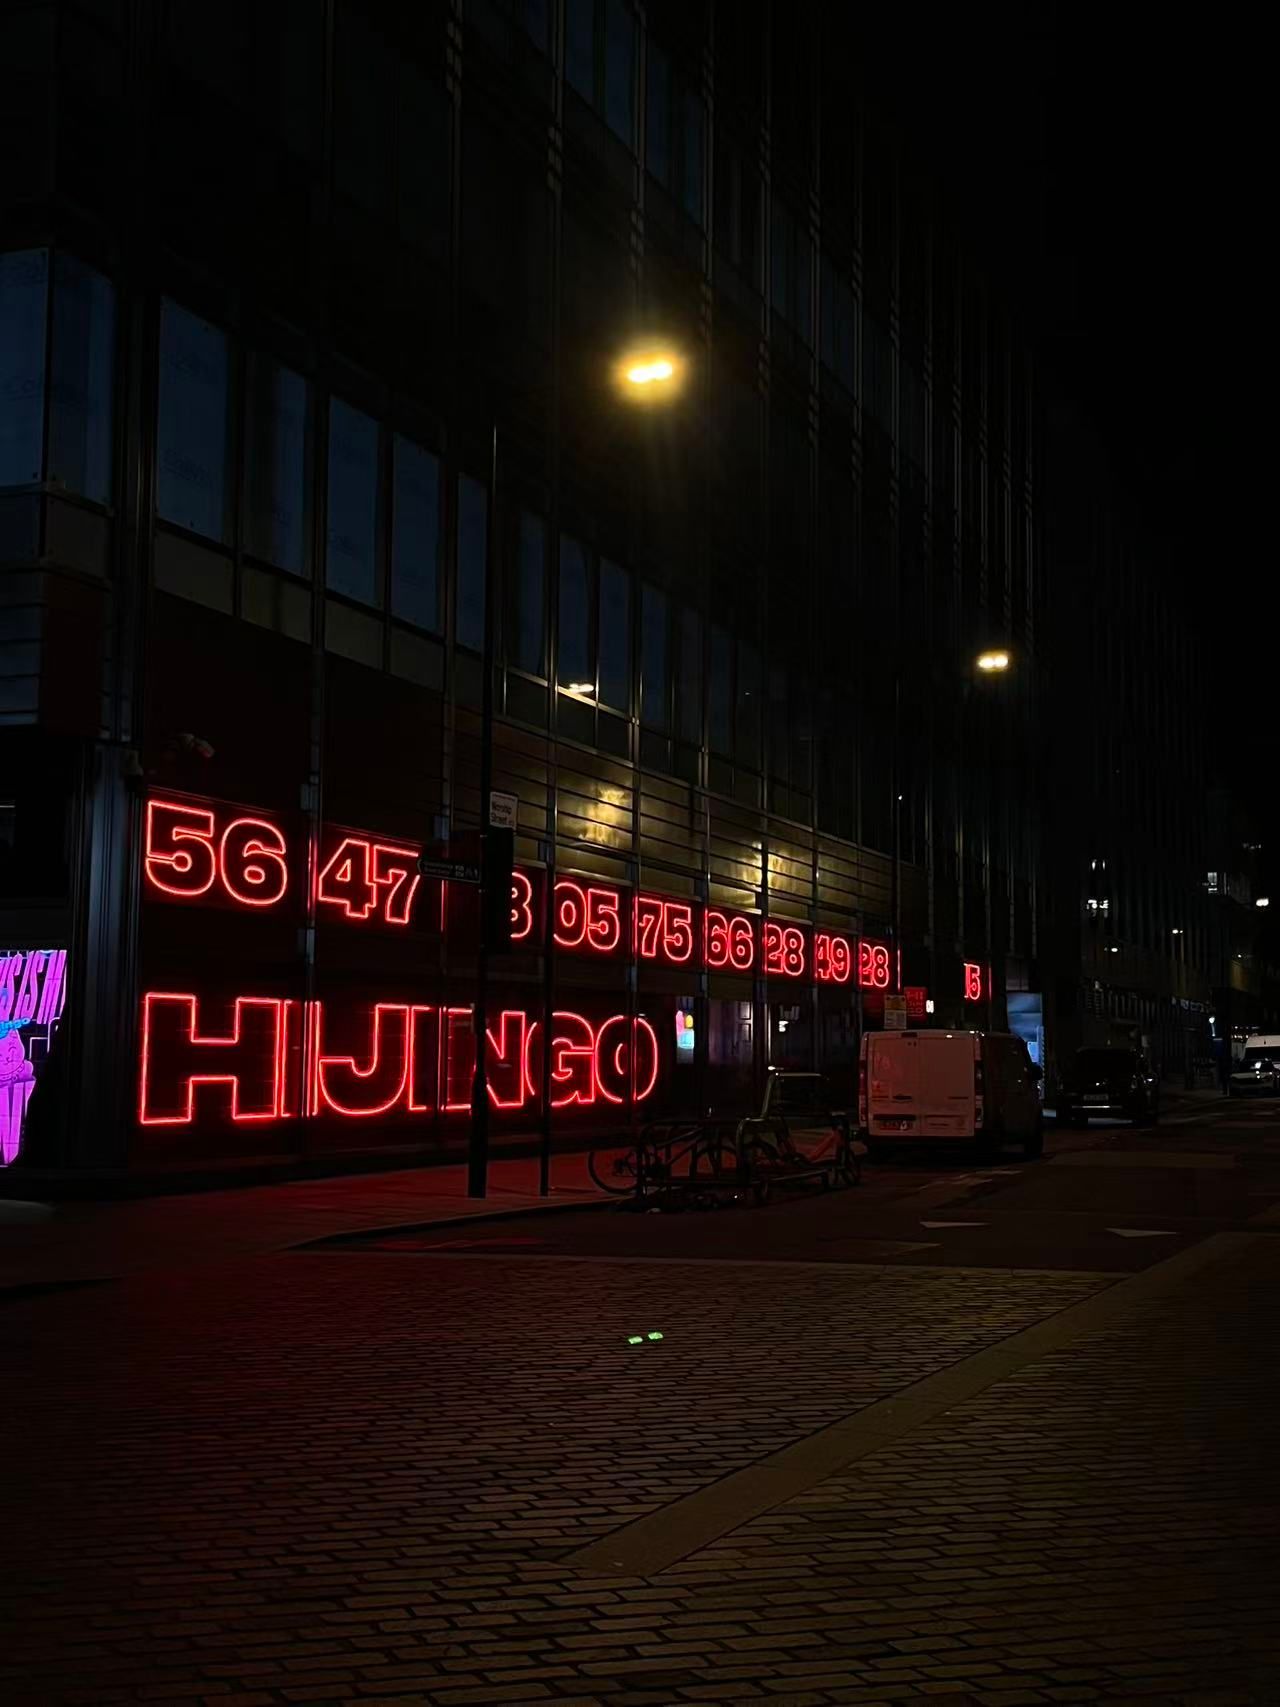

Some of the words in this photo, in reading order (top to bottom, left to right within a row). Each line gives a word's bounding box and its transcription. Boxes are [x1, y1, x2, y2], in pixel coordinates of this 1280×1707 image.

[145, 799, 288, 905] 56
[318, 837, 421, 924] 47
[553, 881, 620, 950] 05
[638, 897, 693, 961] 75
[707, 911, 754, 969] 66
[766, 923, 804, 976] 28
[816, 933, 851, 982] 49
[140, 991, 660, 1125] HIJINGO
